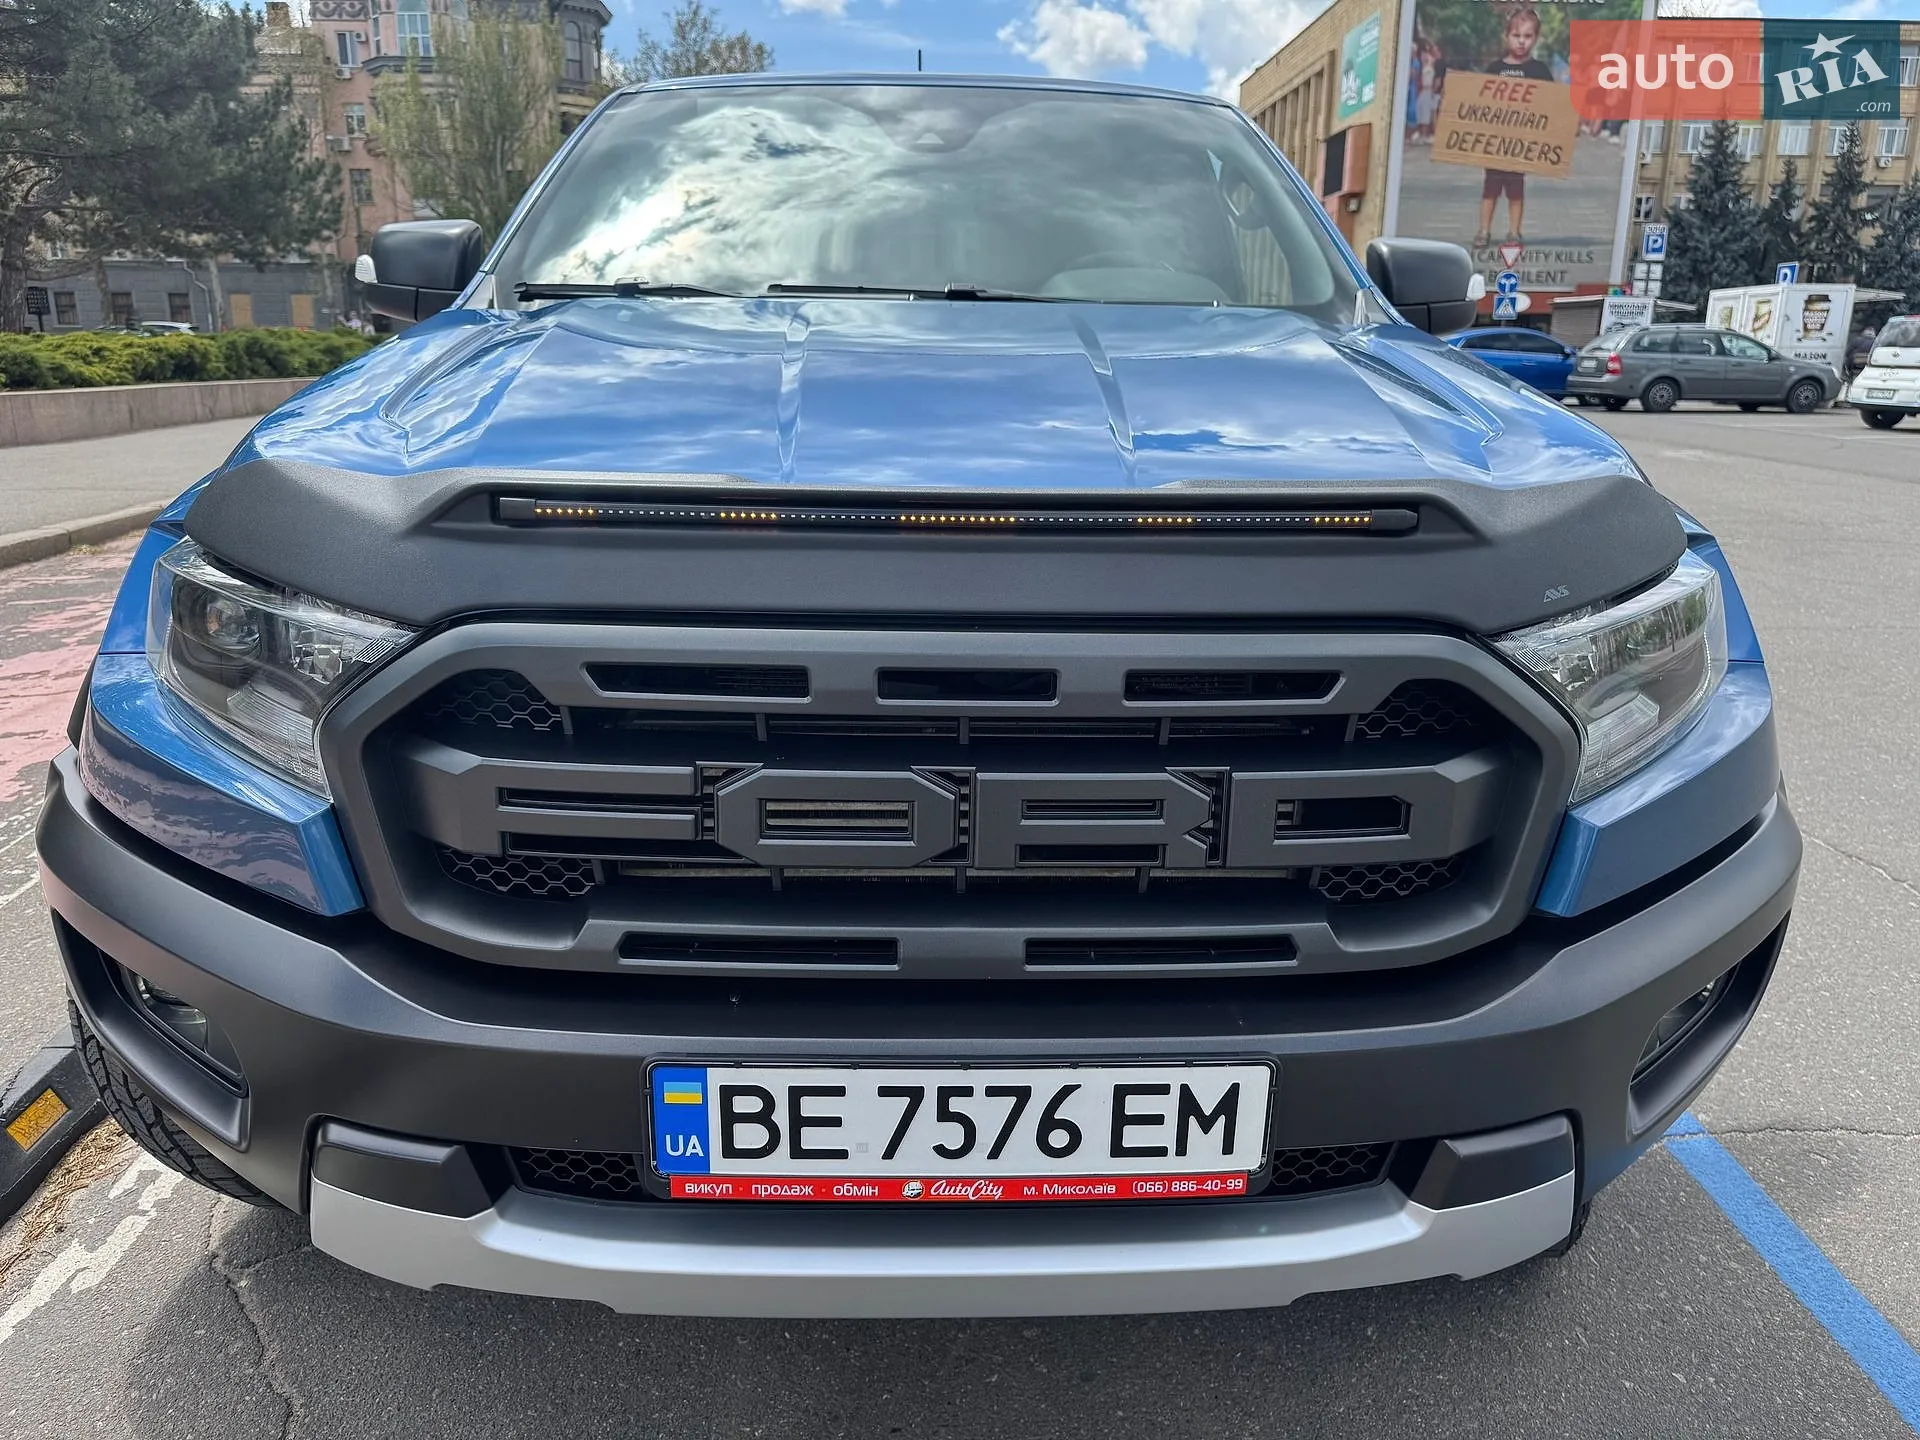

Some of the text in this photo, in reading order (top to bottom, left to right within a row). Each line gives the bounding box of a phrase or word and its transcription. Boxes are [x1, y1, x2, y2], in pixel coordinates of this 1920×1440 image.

[1479, 80, 1538, 103] FREE
[1445, 130, 1563, 165] DEFENDERS
[1476, 249, 1552, 262] CAVITY
[1554, 249, 1595, 263] KILLS
[460, 760, 1454, 869] FORD
[718, 1082, 1241, 1160] BE 7576 EM
[665, 1135, 704, 1157] UA
[684, 1182, 878, 1197] викуп продаж обмін
[930, 1180, 1003, 1200] AutoCity
[1023, 1178, 1243, 1195] м. Миколаїв (066) 886-40-99
